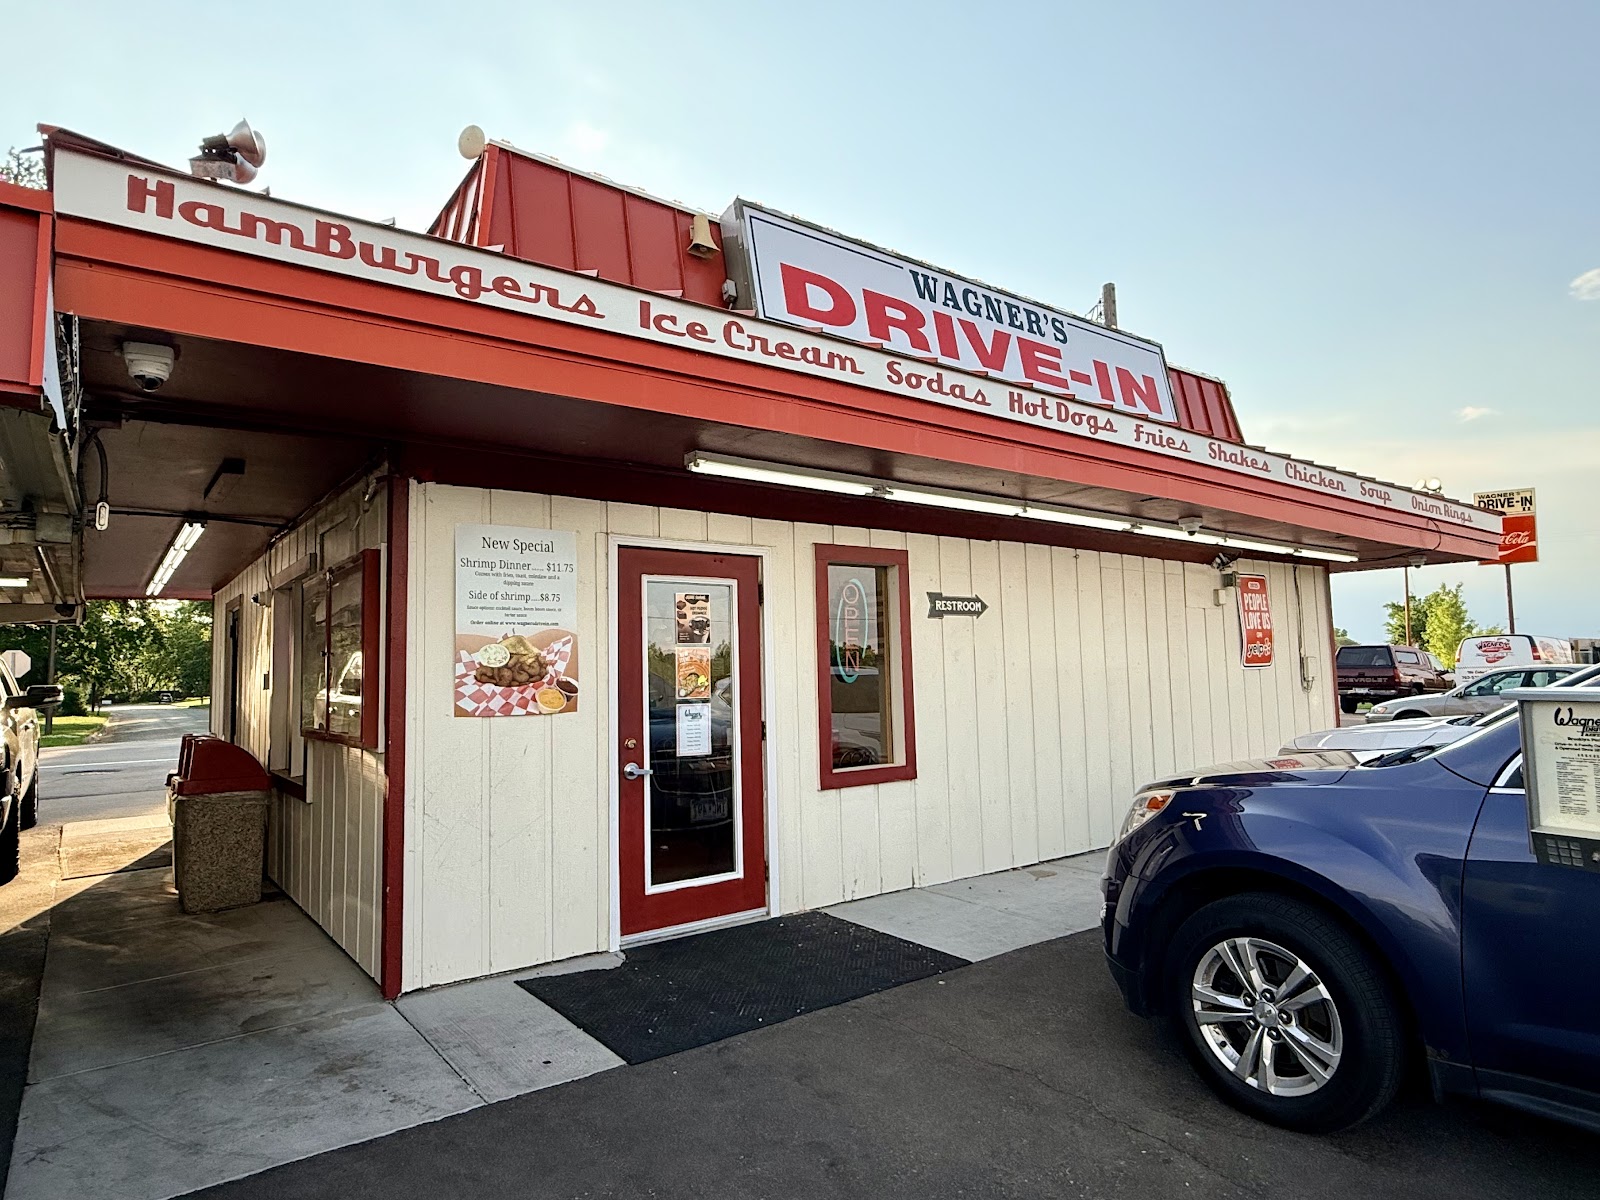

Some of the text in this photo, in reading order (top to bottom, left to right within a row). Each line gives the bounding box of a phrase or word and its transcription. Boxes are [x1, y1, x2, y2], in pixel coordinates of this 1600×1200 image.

[909, 269, 1068, 344] WAGNER'S
[780, 262, 1163, 415] DRIVE-IN
[639, 300, 716, 343] Ice
[723, 320, 865, 375] Cream
[886, 360, 991, 406] Sodas
[1008, 391, 1054, 420] Hot
[1055, 401, 1118, 435] Dogs
[1208, 441, 1271, 473] Shakes
[1284, 462, 1346, 492] Chicken
[1359, 482, 1392, 504] Soup
[1411, 495, 1443, 516] Onion
[1443, 503, 1473, 524] Rings
[1478, 495, 1533, 509] DRIVE-IN
[481, 536, 554, 554] New Special
[460, 557, 497, 571] Shrimp
[546, 562, 574, 573] $11.75
[468, 590, 488, 600] Side
[489, 590, 500, 600] of
[1243, 592, 1268, 611] PEOPLE
[935, 599, 982, 612] RESTROOM
[842, 584, 860, 672] OPEN
[1244, 612, 1271, 630] LOVE US
